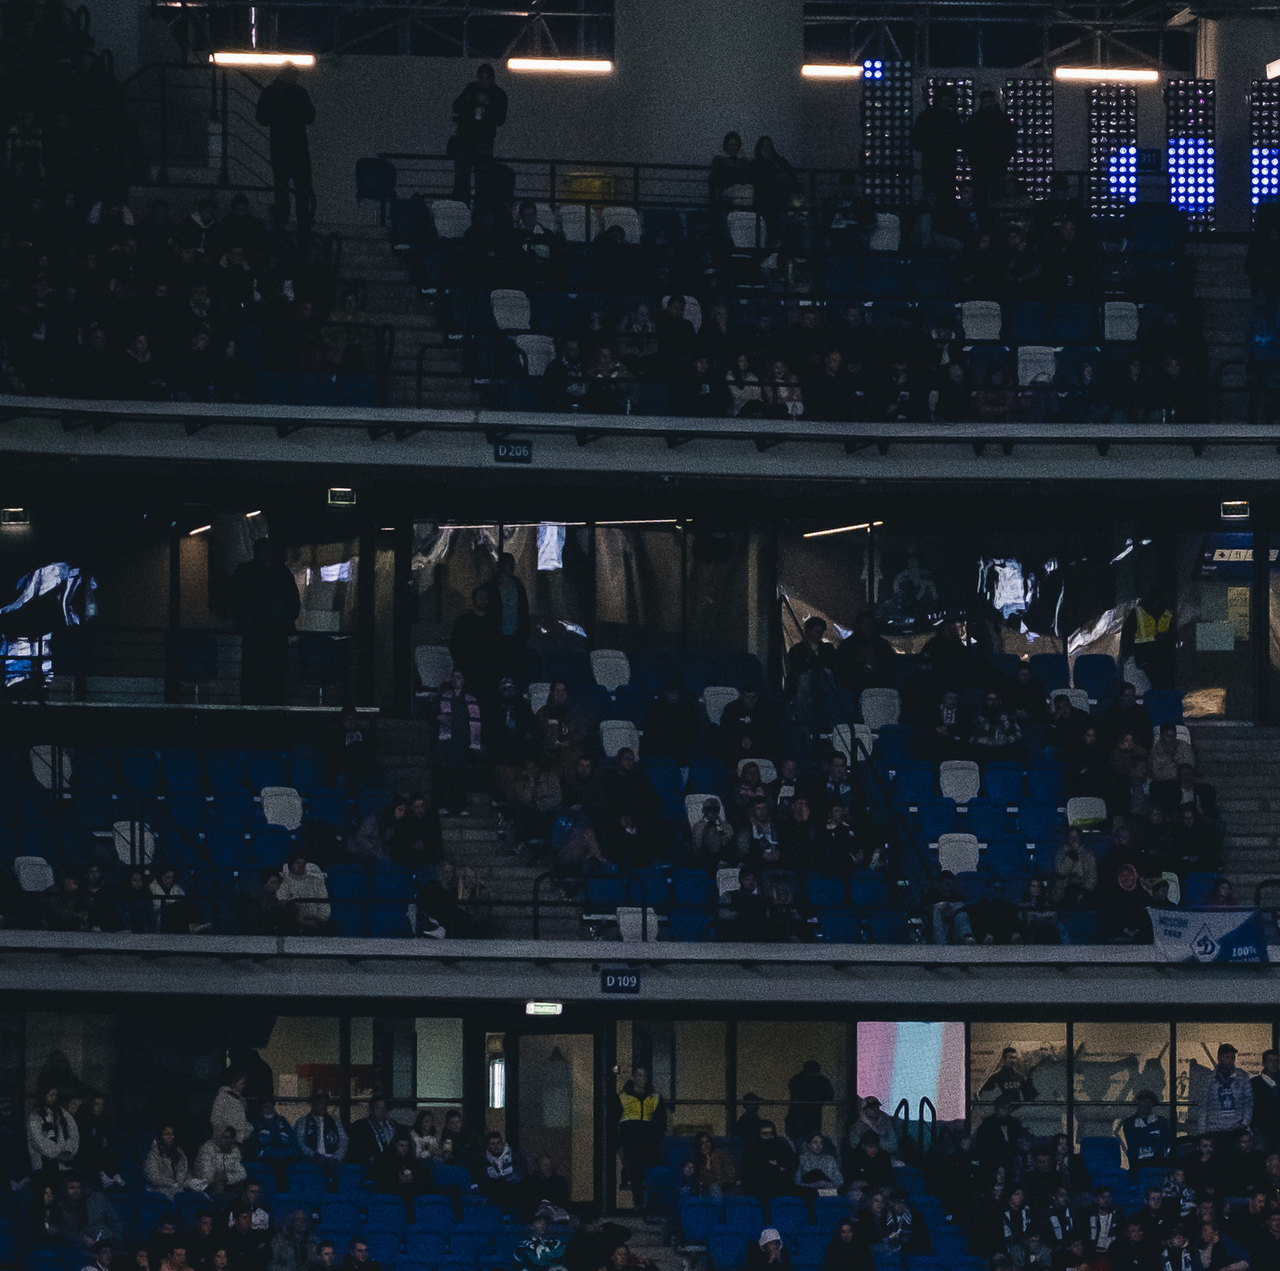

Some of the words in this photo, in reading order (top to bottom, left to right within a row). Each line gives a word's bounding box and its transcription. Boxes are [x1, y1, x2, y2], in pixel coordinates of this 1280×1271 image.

[499, 444, 507, 456] D
[509, 445, 529, 457] 206
[606, 975, 615, 987] D
[617, 975, 637, 987] 109
